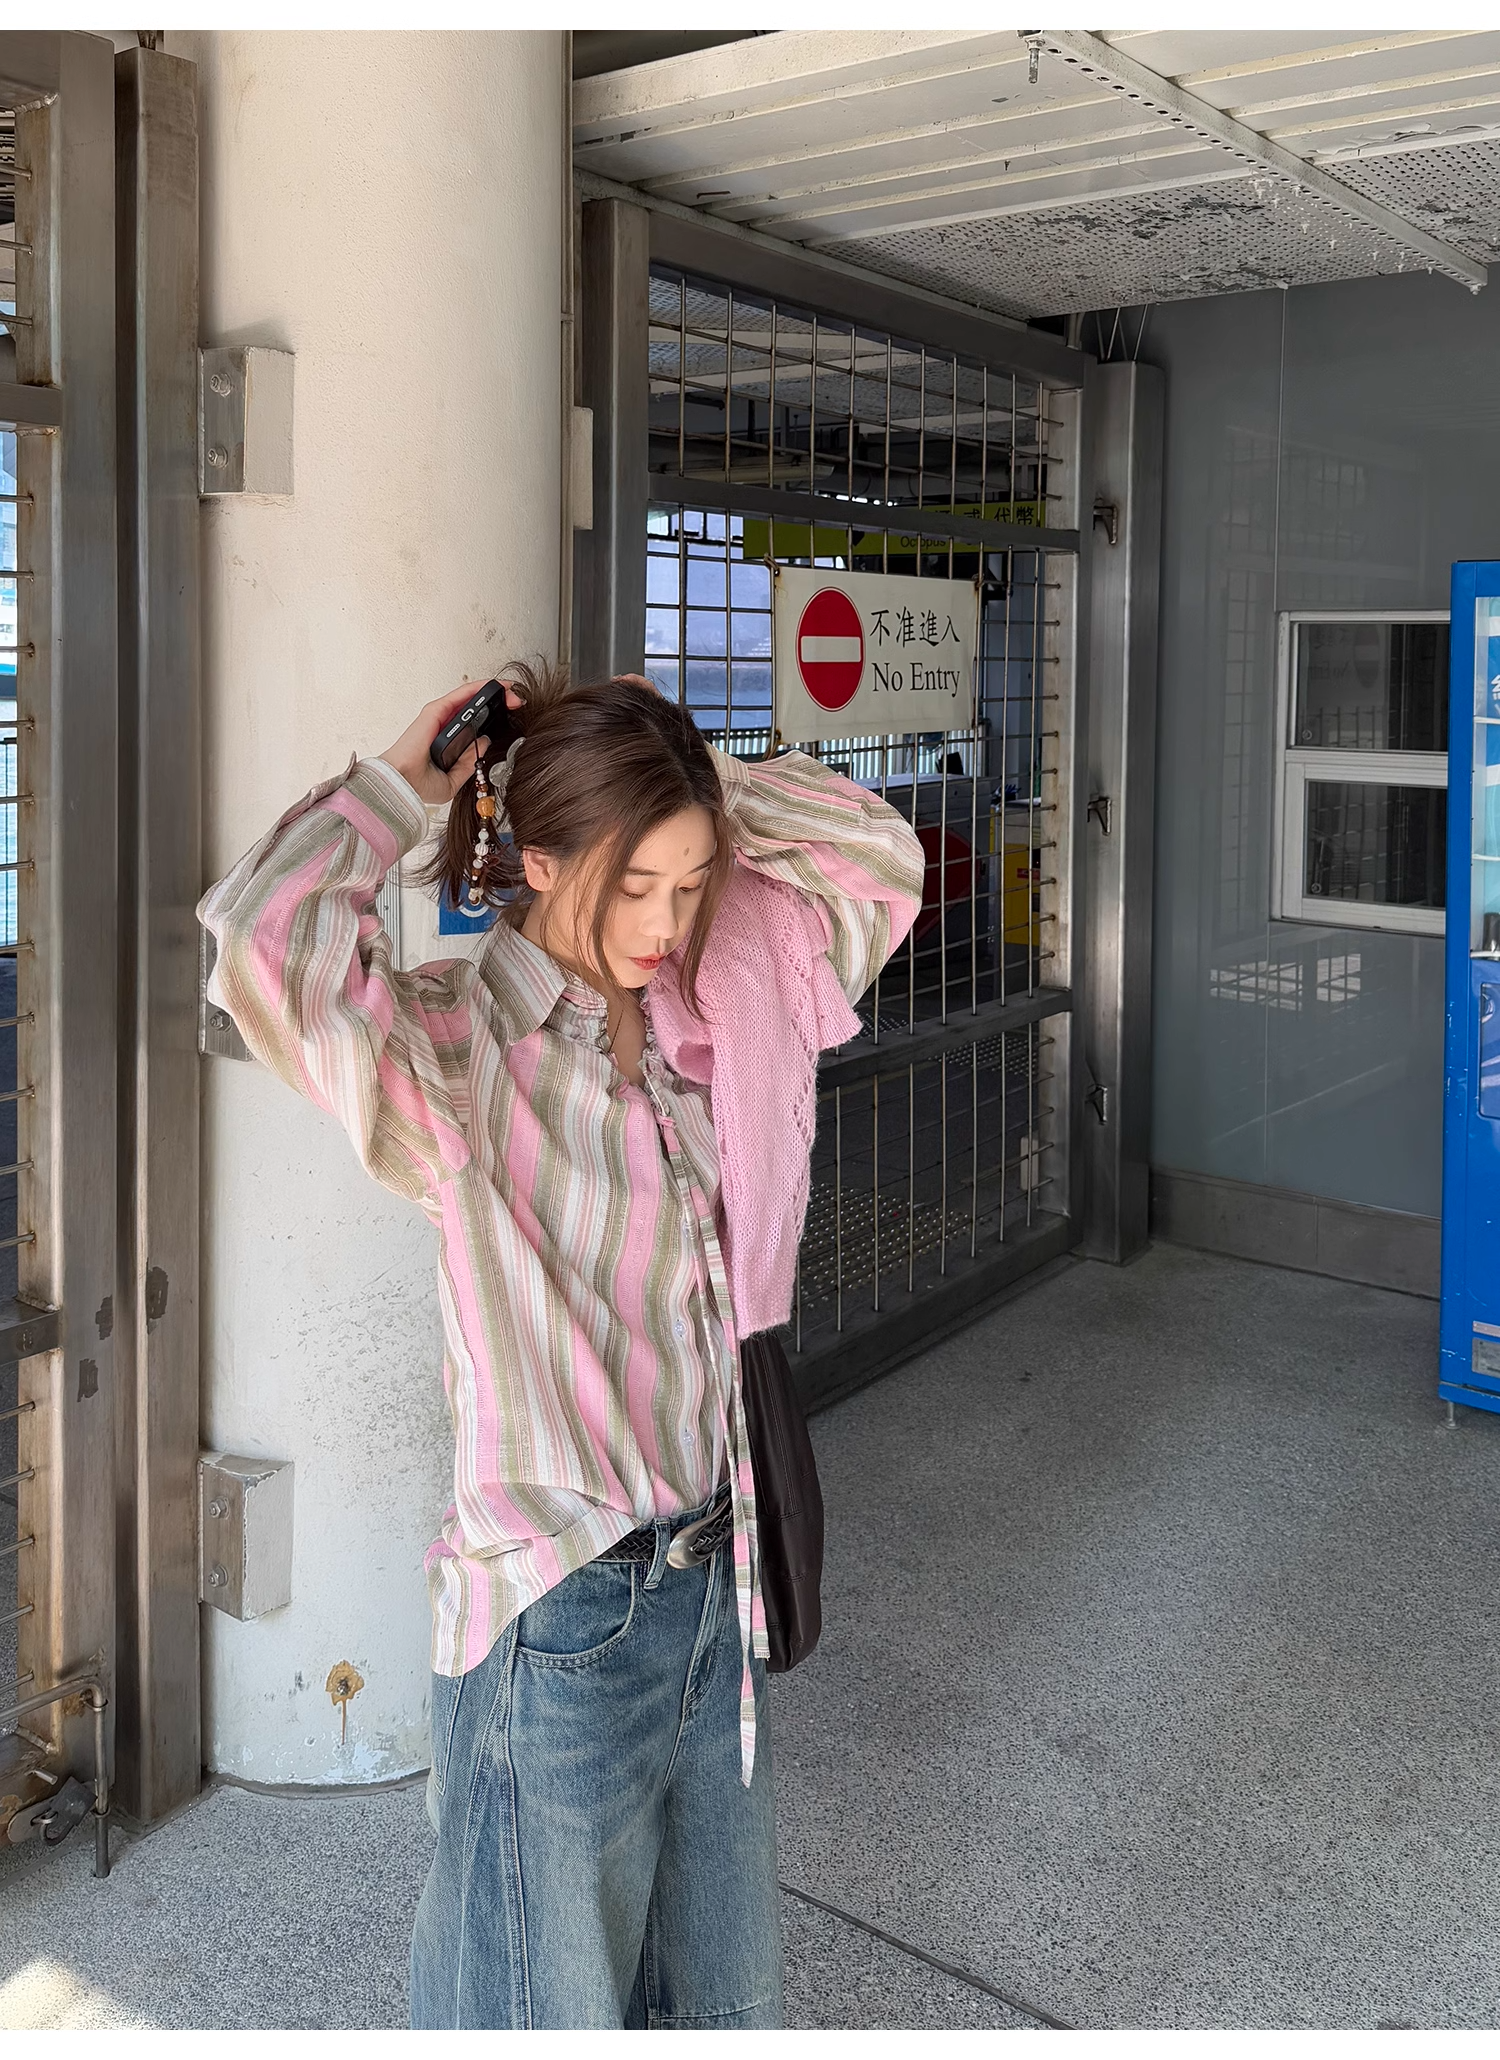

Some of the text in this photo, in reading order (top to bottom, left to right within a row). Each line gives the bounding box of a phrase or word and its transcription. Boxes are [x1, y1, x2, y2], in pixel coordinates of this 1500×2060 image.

[900, 535, 946, 549] Ocopus
[869, 606, 961, 648] 不准進入
[871, 662, 960, 698] No Entry
